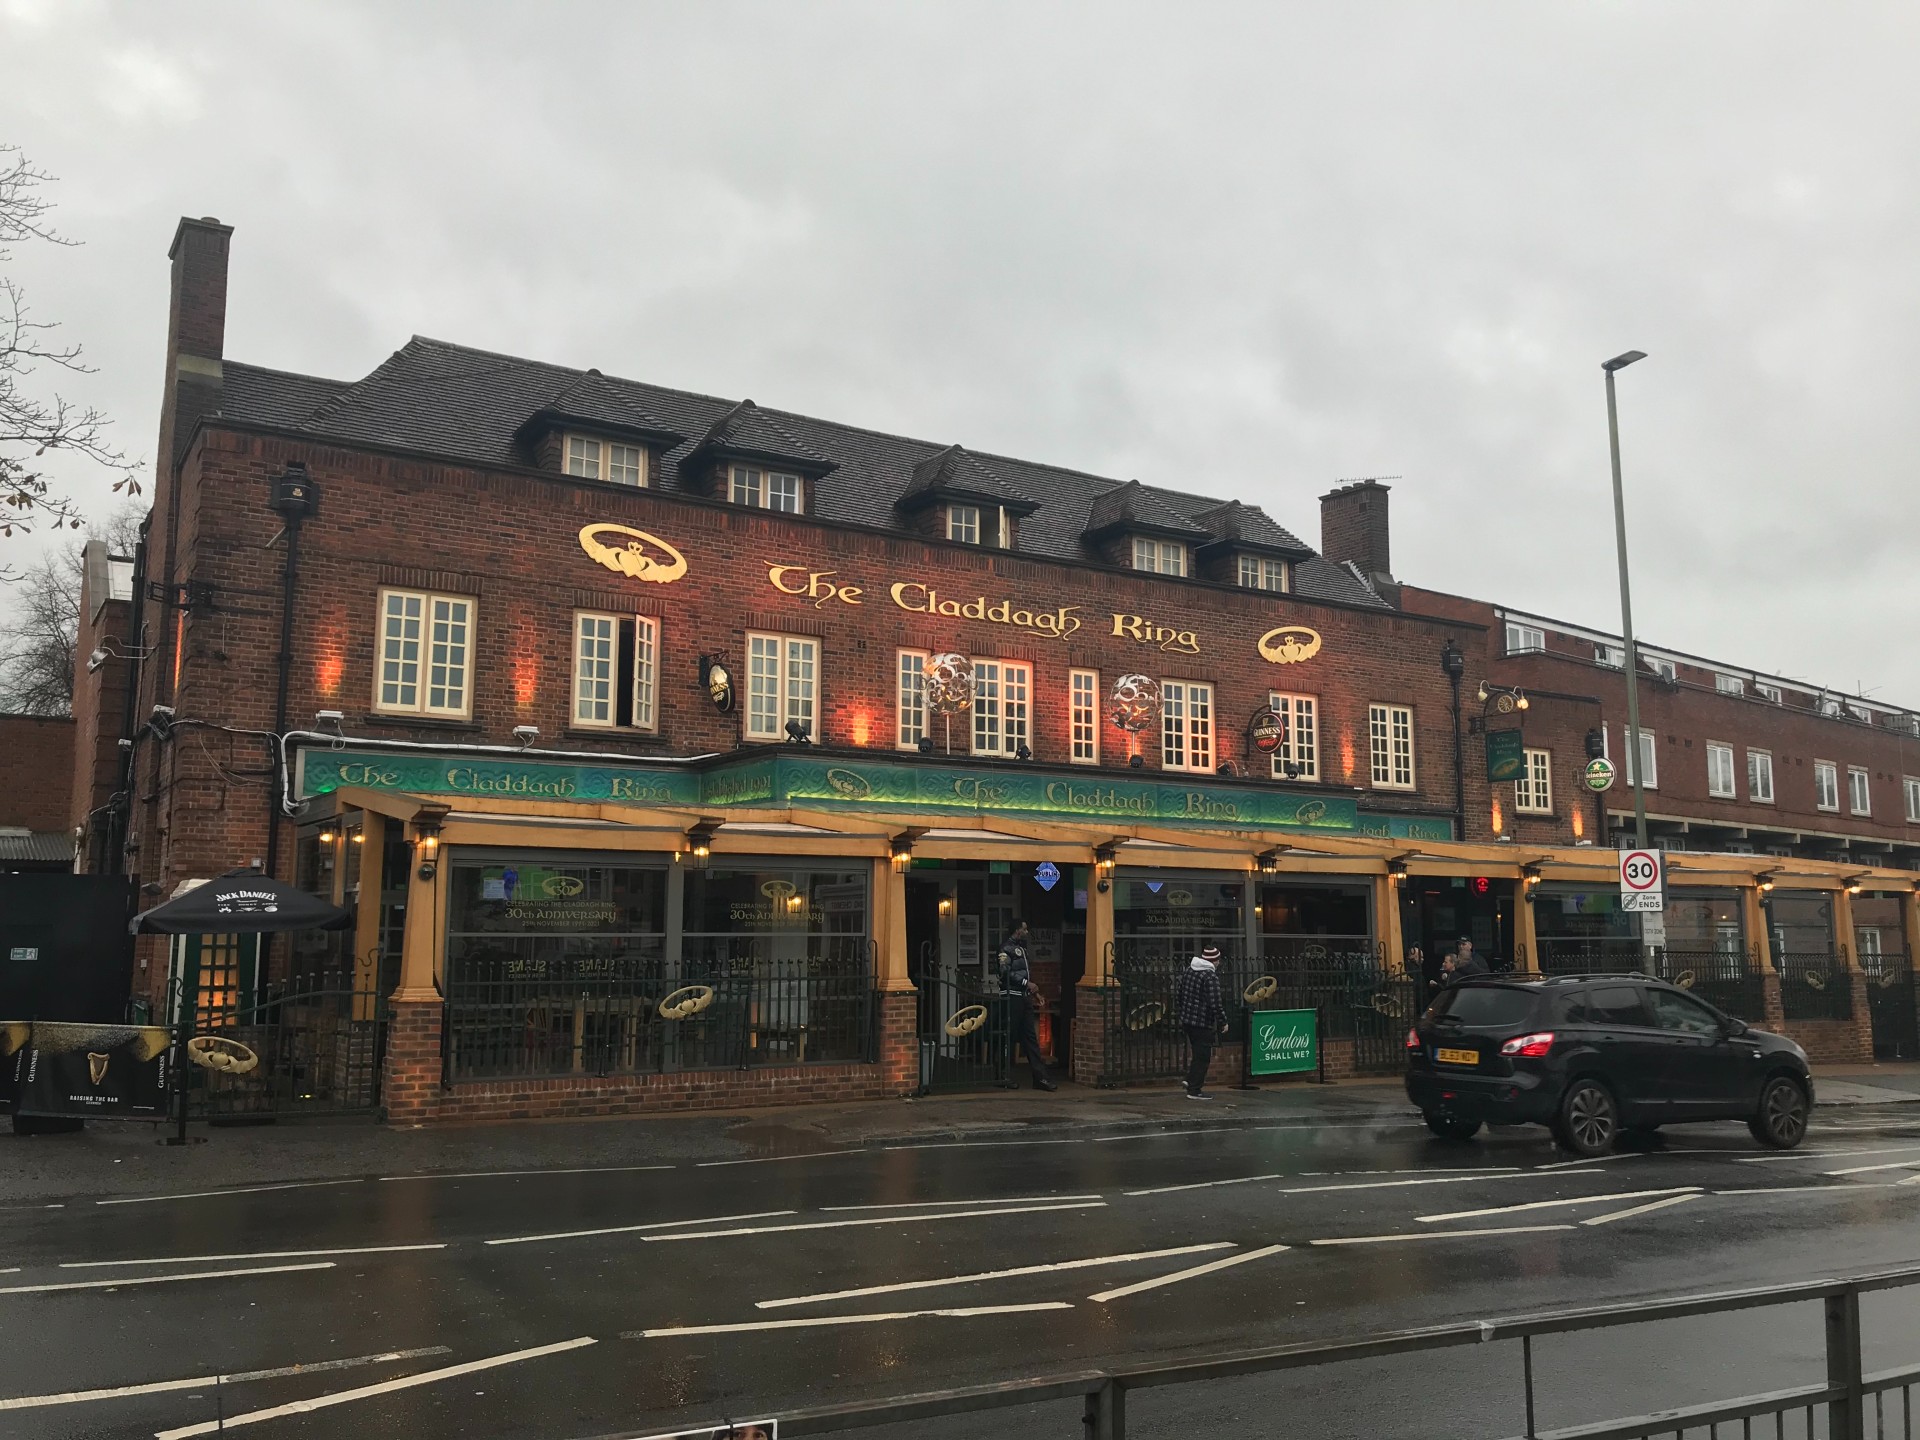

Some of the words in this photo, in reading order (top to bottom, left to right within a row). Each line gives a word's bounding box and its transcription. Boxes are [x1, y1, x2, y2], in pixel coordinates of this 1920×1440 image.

[763, 560, 863, 610] The
[889, 582, 1082, 641] Claddagh
[1110, 613, 1200, 654] Ring
[1253, 726, 1281, 737] GUINNESS
[337, 761, 398, 785] The
[447, 767, 575, 797] Claddagh
[952, 774, 1003, 801] The
[1046, 781, 1154, 817] Claddagh
[1186, 792, 1238, 821] Ring
[1627, 862, 1653, 879] 30
[215, 892, 240, 901] JACK
[239, 890, 278, 901] DANIEL'S
[504, 908, 535, 920] 30th
[730, 909, 755, 920] 30th
[1260, 1025, 1310, 1051] Gordon's
[1293, 1050, 1310, 1058] WE?
[28, 1049, 39, 1082] GUINNESS
[157, 1055, 166, 1088] GUINNESS
